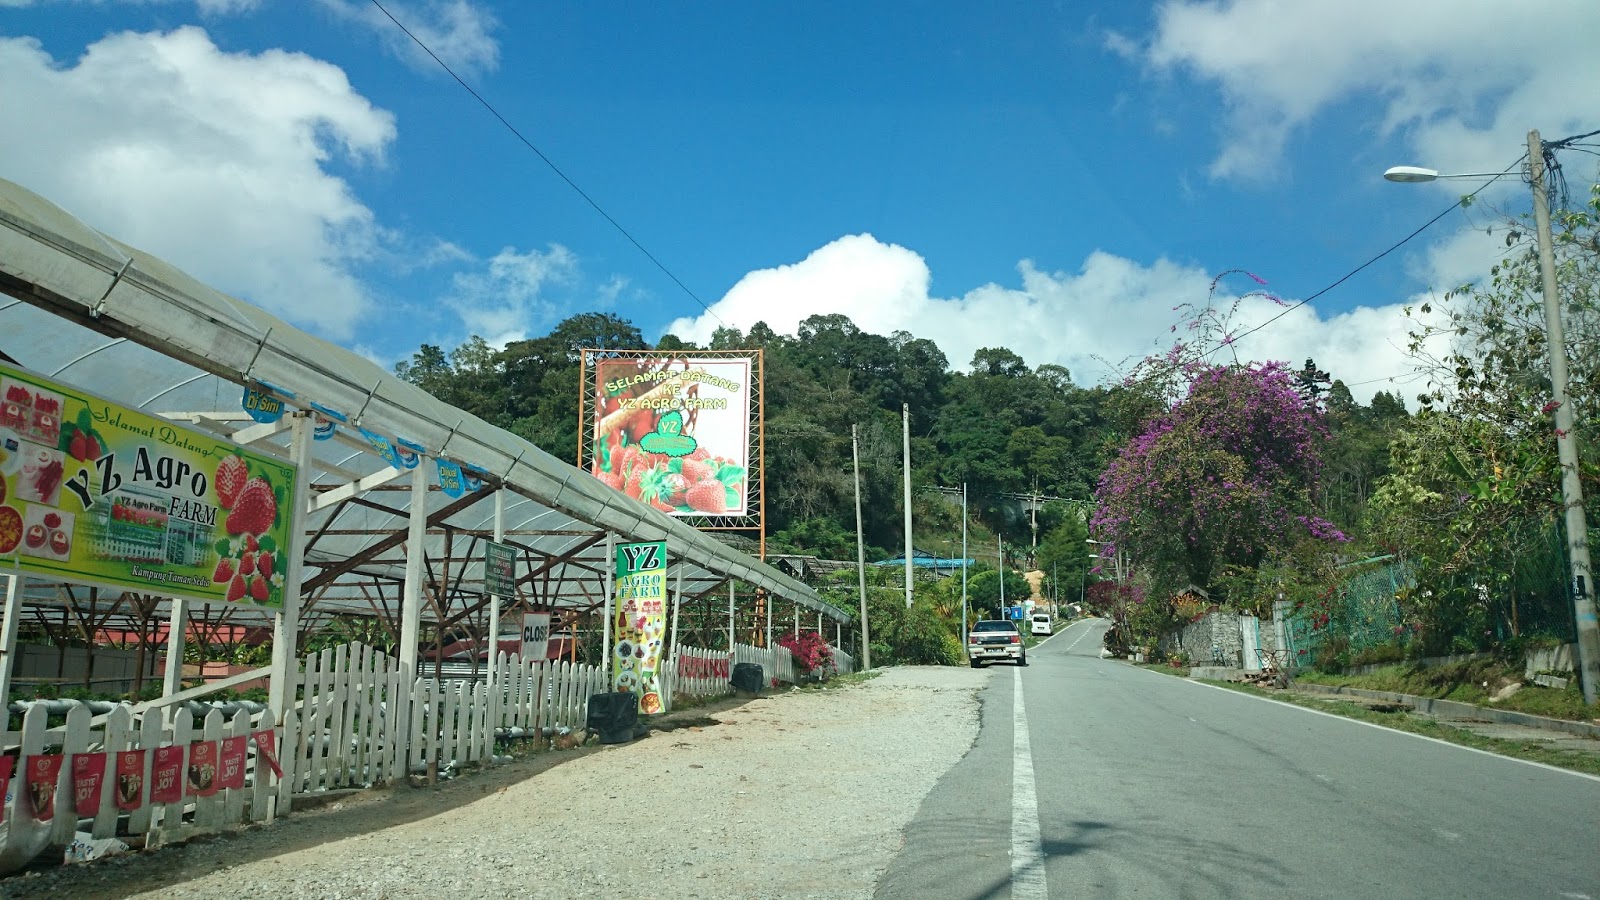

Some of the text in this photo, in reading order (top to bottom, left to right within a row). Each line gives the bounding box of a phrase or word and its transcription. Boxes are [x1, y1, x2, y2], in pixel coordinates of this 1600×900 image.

[606, 370, 740, 393] SELAMAT DATANG
[662, 384, 681, 396] KE
[246, 395, 280, 414] Di Sini
[618, 398, 727, 409] YZ AGRO FARM
[93, 407, 210, 458] Selamat Datang
[660, 421, 679, 434] YZ
[65, 447, 207, 510] YZ Agro
[440, 466, 457, 478] Dijual
[121, 496, 167, 514] YZ Agro Farm
[167, 496, 218, 527] FARM
[622, 544, 660, 572] YZ
[131, 565, 211, 588] Kampung Taman Sedia
[620, 575, 661, 588] AGRO
[620, 586, 662, 599] FARM
[524, 626, 548, 642] CLOSE
[225, 756, 240, 766] TASTE
[158, 768, 176, 778] TASTE
[225, 765, 239, 777] JOY
[76, 778, 97, 788] TASTE
[157, 777, 175, 790] JOY
[76, 787, 95, 800] JOY
